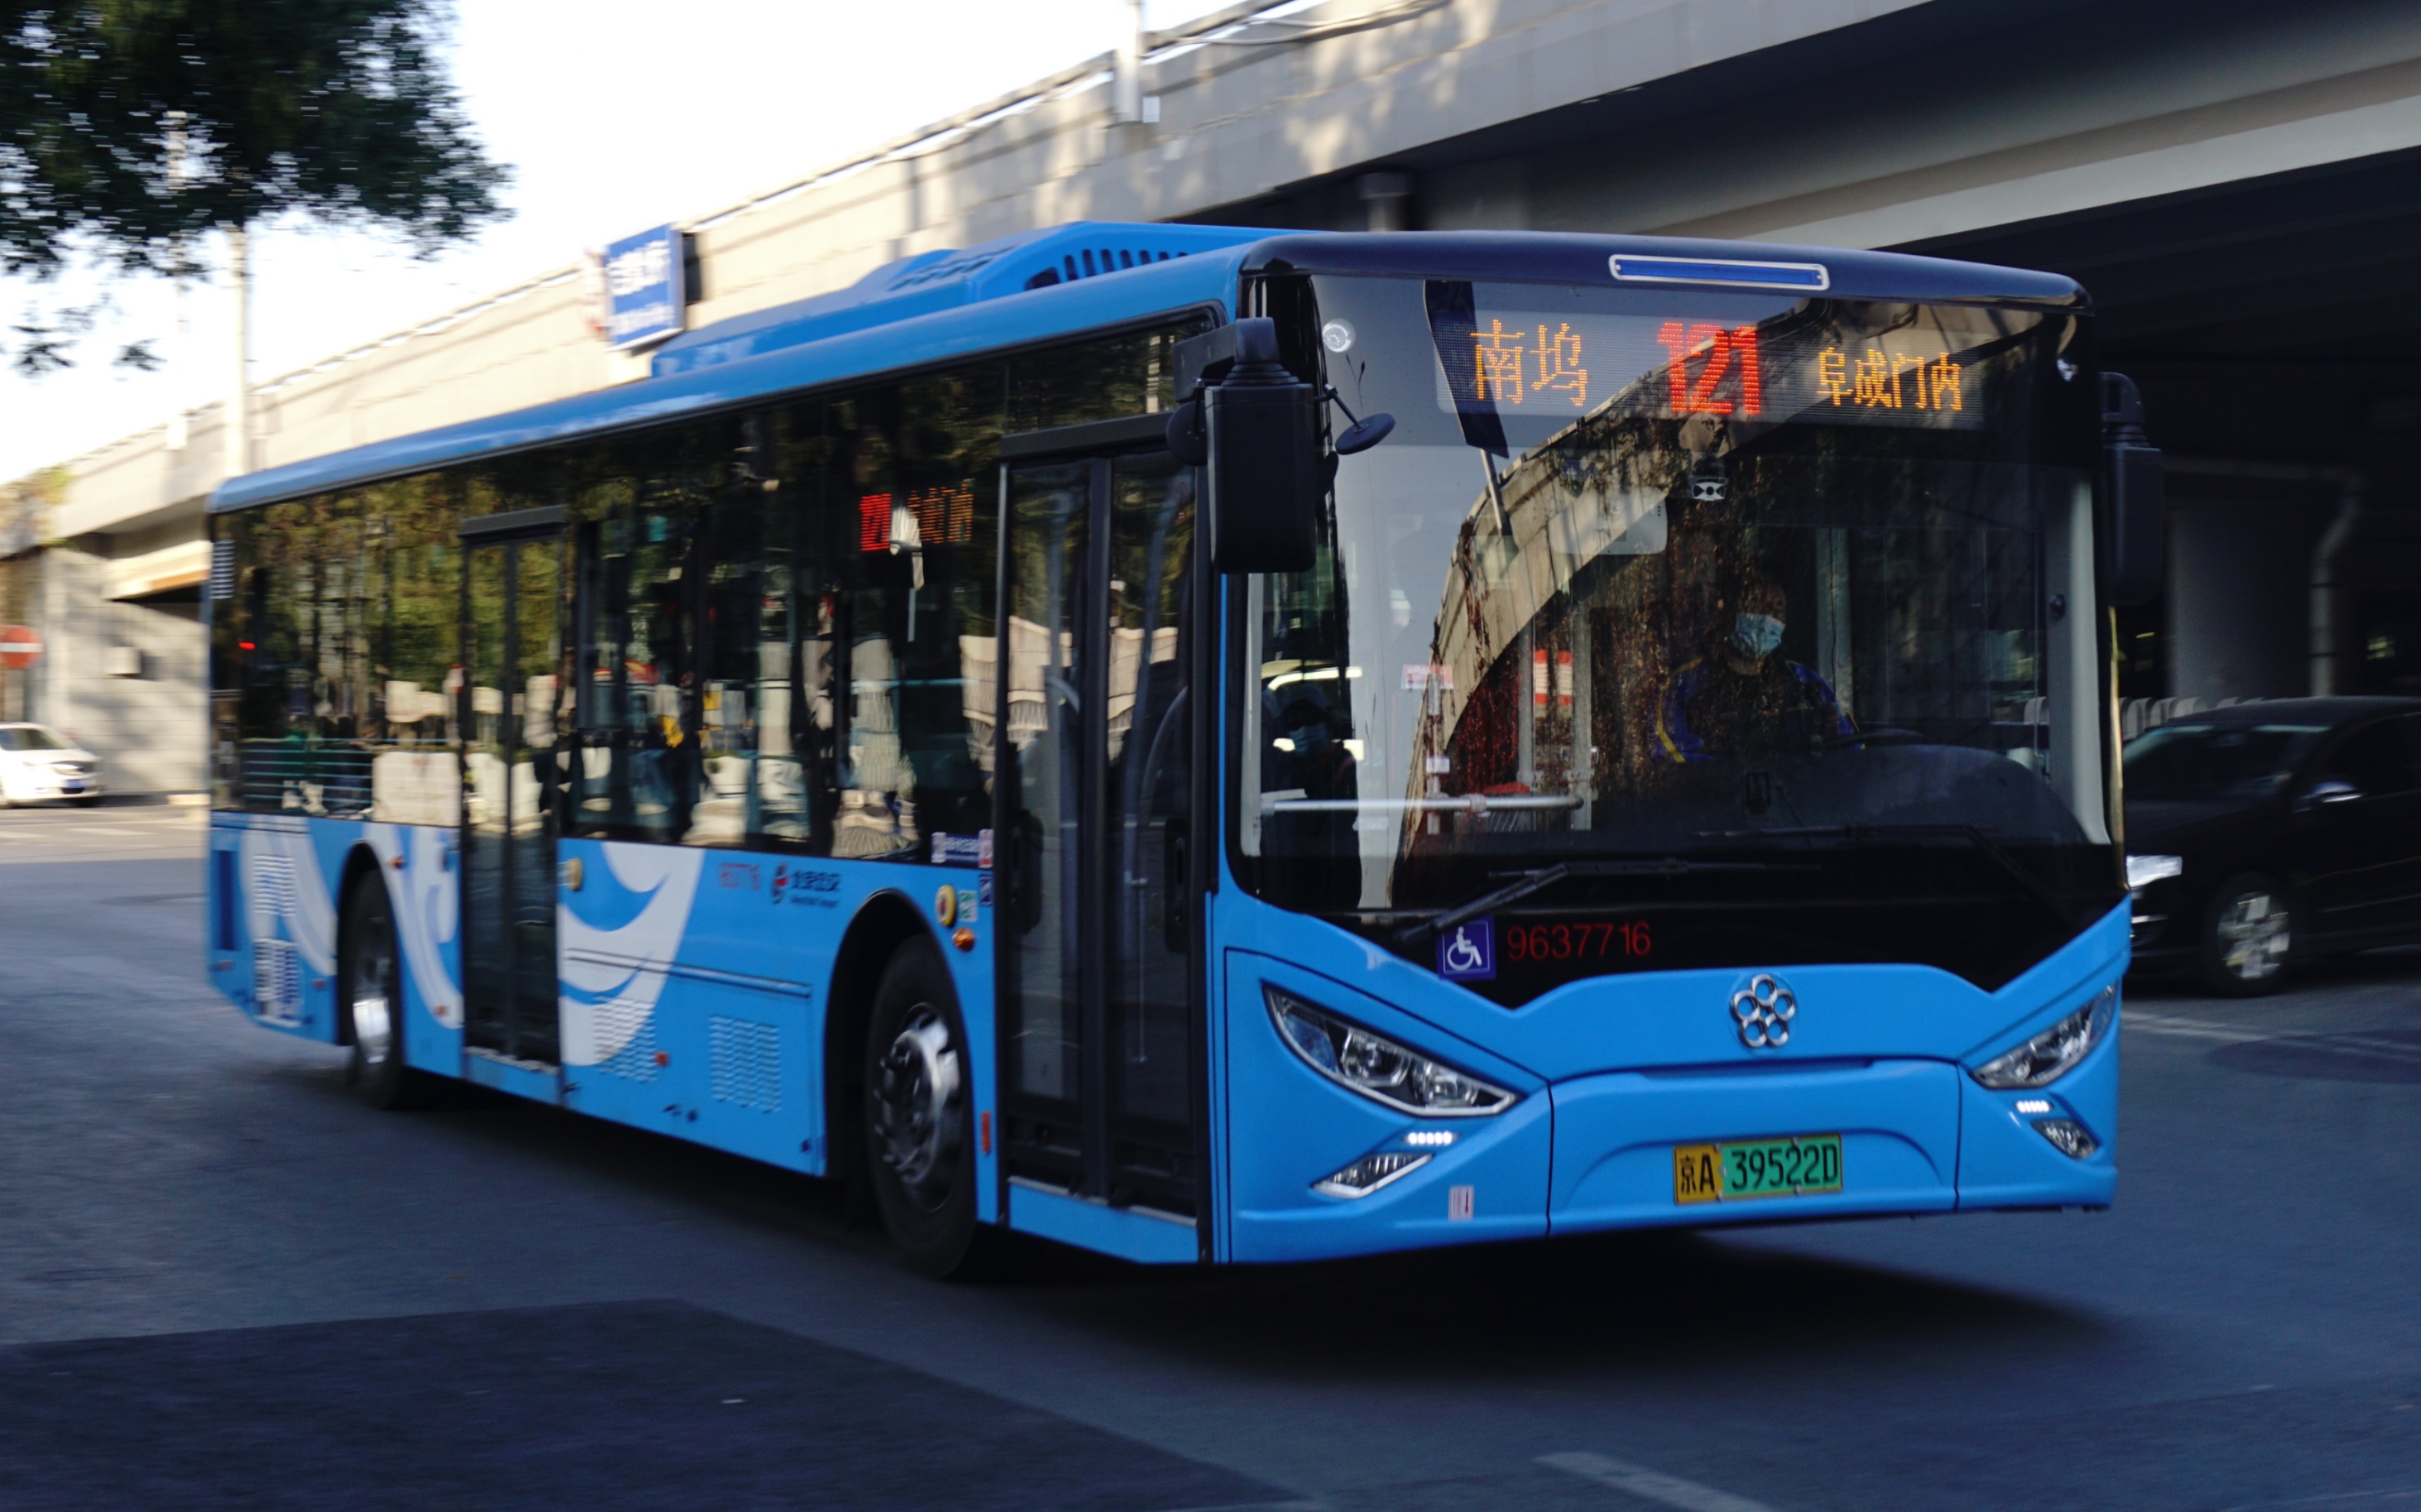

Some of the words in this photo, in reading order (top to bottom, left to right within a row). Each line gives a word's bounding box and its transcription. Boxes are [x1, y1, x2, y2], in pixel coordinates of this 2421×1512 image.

[1470, 319, 1588, 407] 南坞
[1657, 322, 1761, 415] 121
[1816, 346, 1963, 411] 阜成门内
[1507, 921, 1652, 961] 9637716
[1680, 1154, 1715, 1193] 京A
[1731, 1145, 1838, 1190] 39522D
